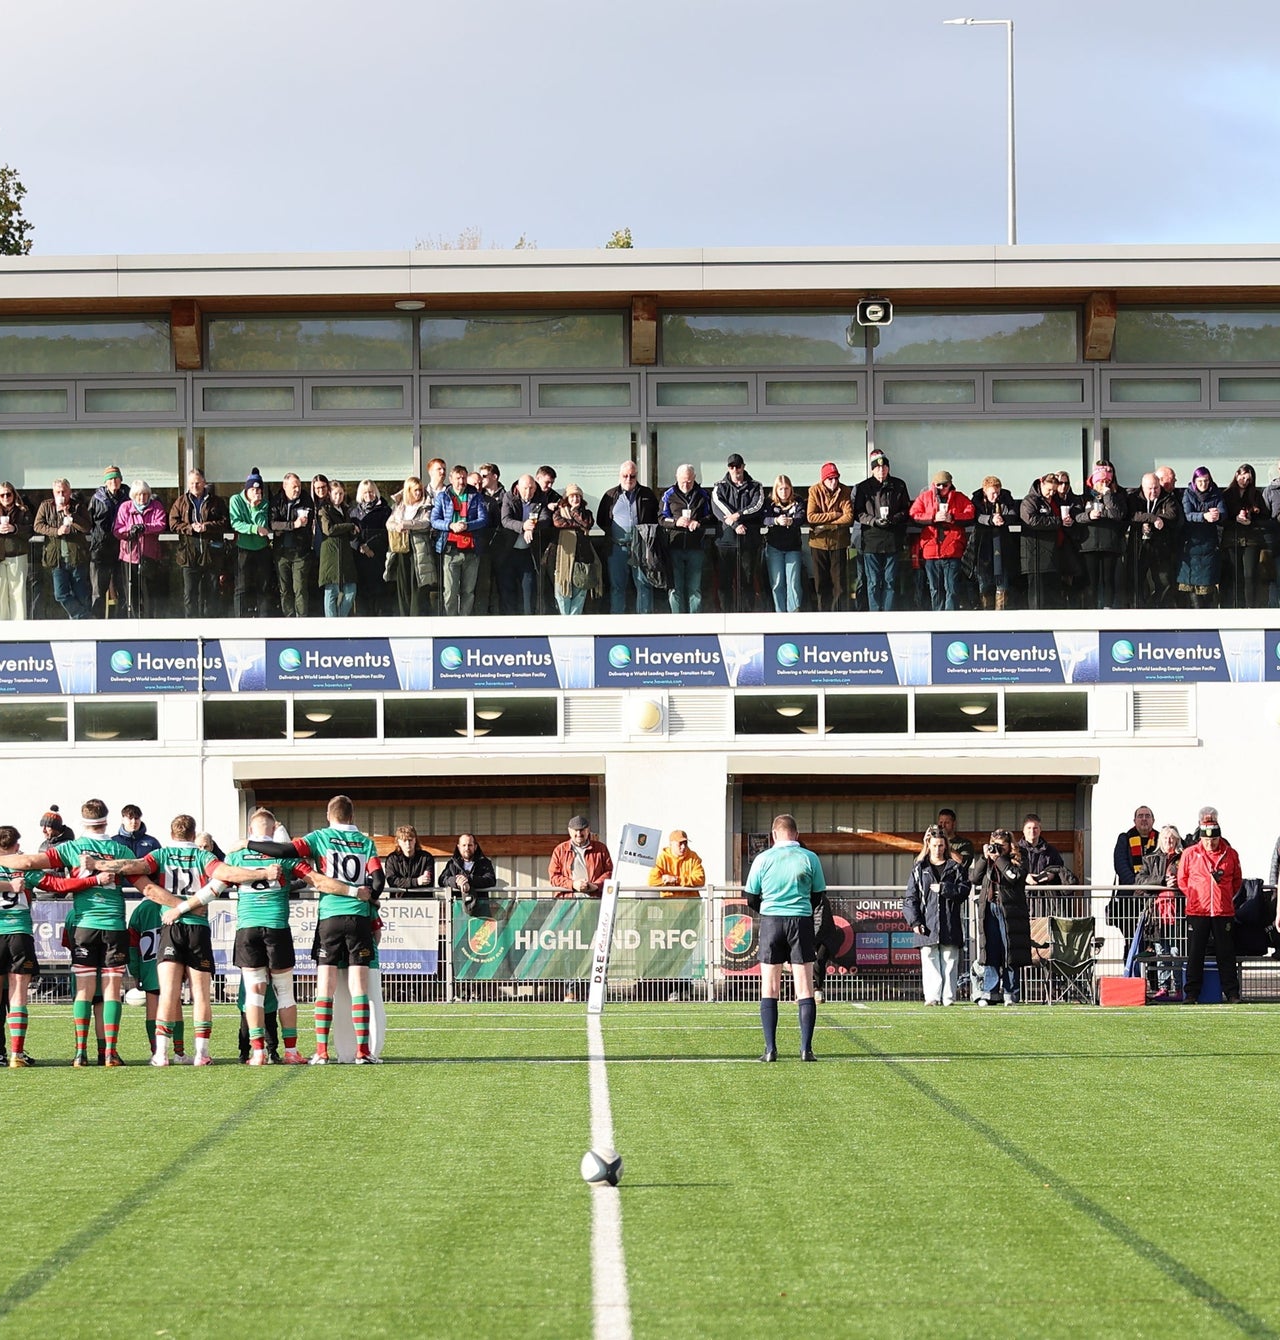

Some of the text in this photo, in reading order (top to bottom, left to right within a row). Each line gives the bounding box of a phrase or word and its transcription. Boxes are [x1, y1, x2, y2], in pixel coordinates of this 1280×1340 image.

[306, 651, 390, 668] Haventus
[467, 649, 552, 666] Haventus
[636, 648, 720, 664] Haventus
[804, 646, 888, 662] Haventus
[973, 644, 1056, 661] Haventus
[1138, 643, 1221, 660] Haventus
[333, 853, 360, 882] 10
[171, 868, 193, 895] 12
[2, 891, 18, 909] 9
[856, 901, 903, 910] JOIN THE
[381, 907, 434, 918] STRIAL
[650, 929, 697, 950] RFC
[862, 937, 884, 945] TEAMS
[857, 953, 888, 961] BANNERS
[895, 953, 920, 961] EVENTS
[379, 962, 421, 970] 7833 910306
